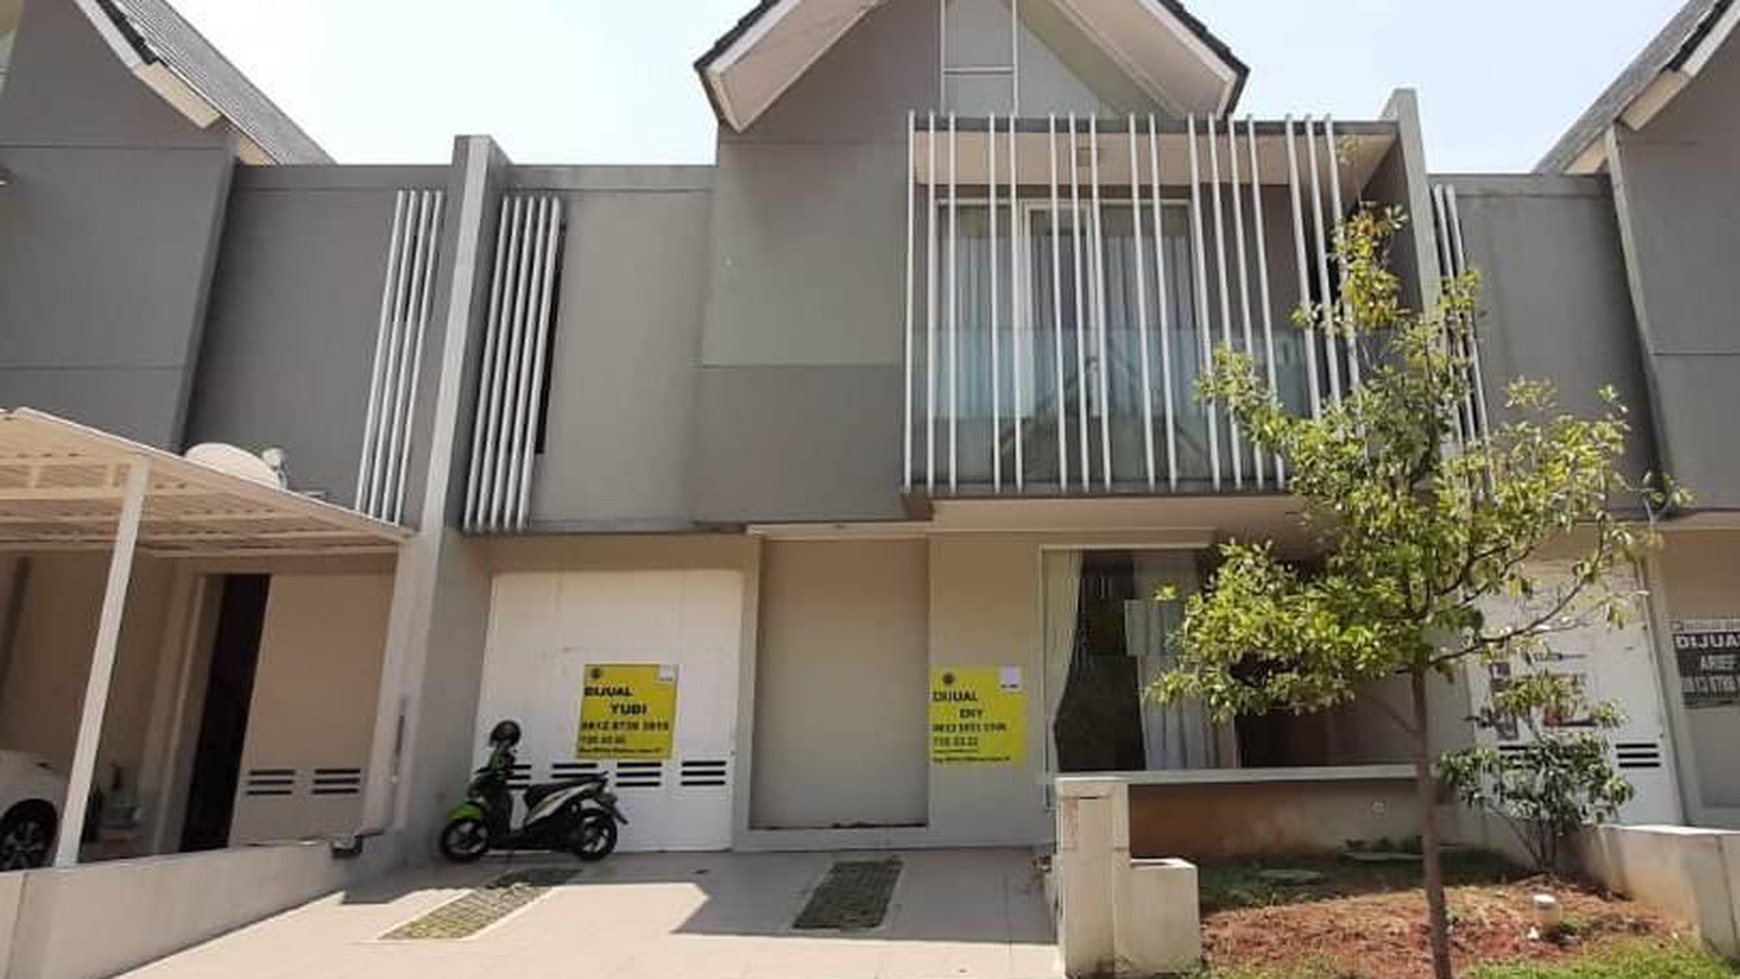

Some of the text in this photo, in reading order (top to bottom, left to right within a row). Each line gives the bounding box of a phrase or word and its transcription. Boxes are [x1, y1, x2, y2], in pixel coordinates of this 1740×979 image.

[1675, 634, 1740, 648] DIJUA
[584, 686, 633, 697] DIJUAL
[933, 691, 978, 701] DIJUAL
